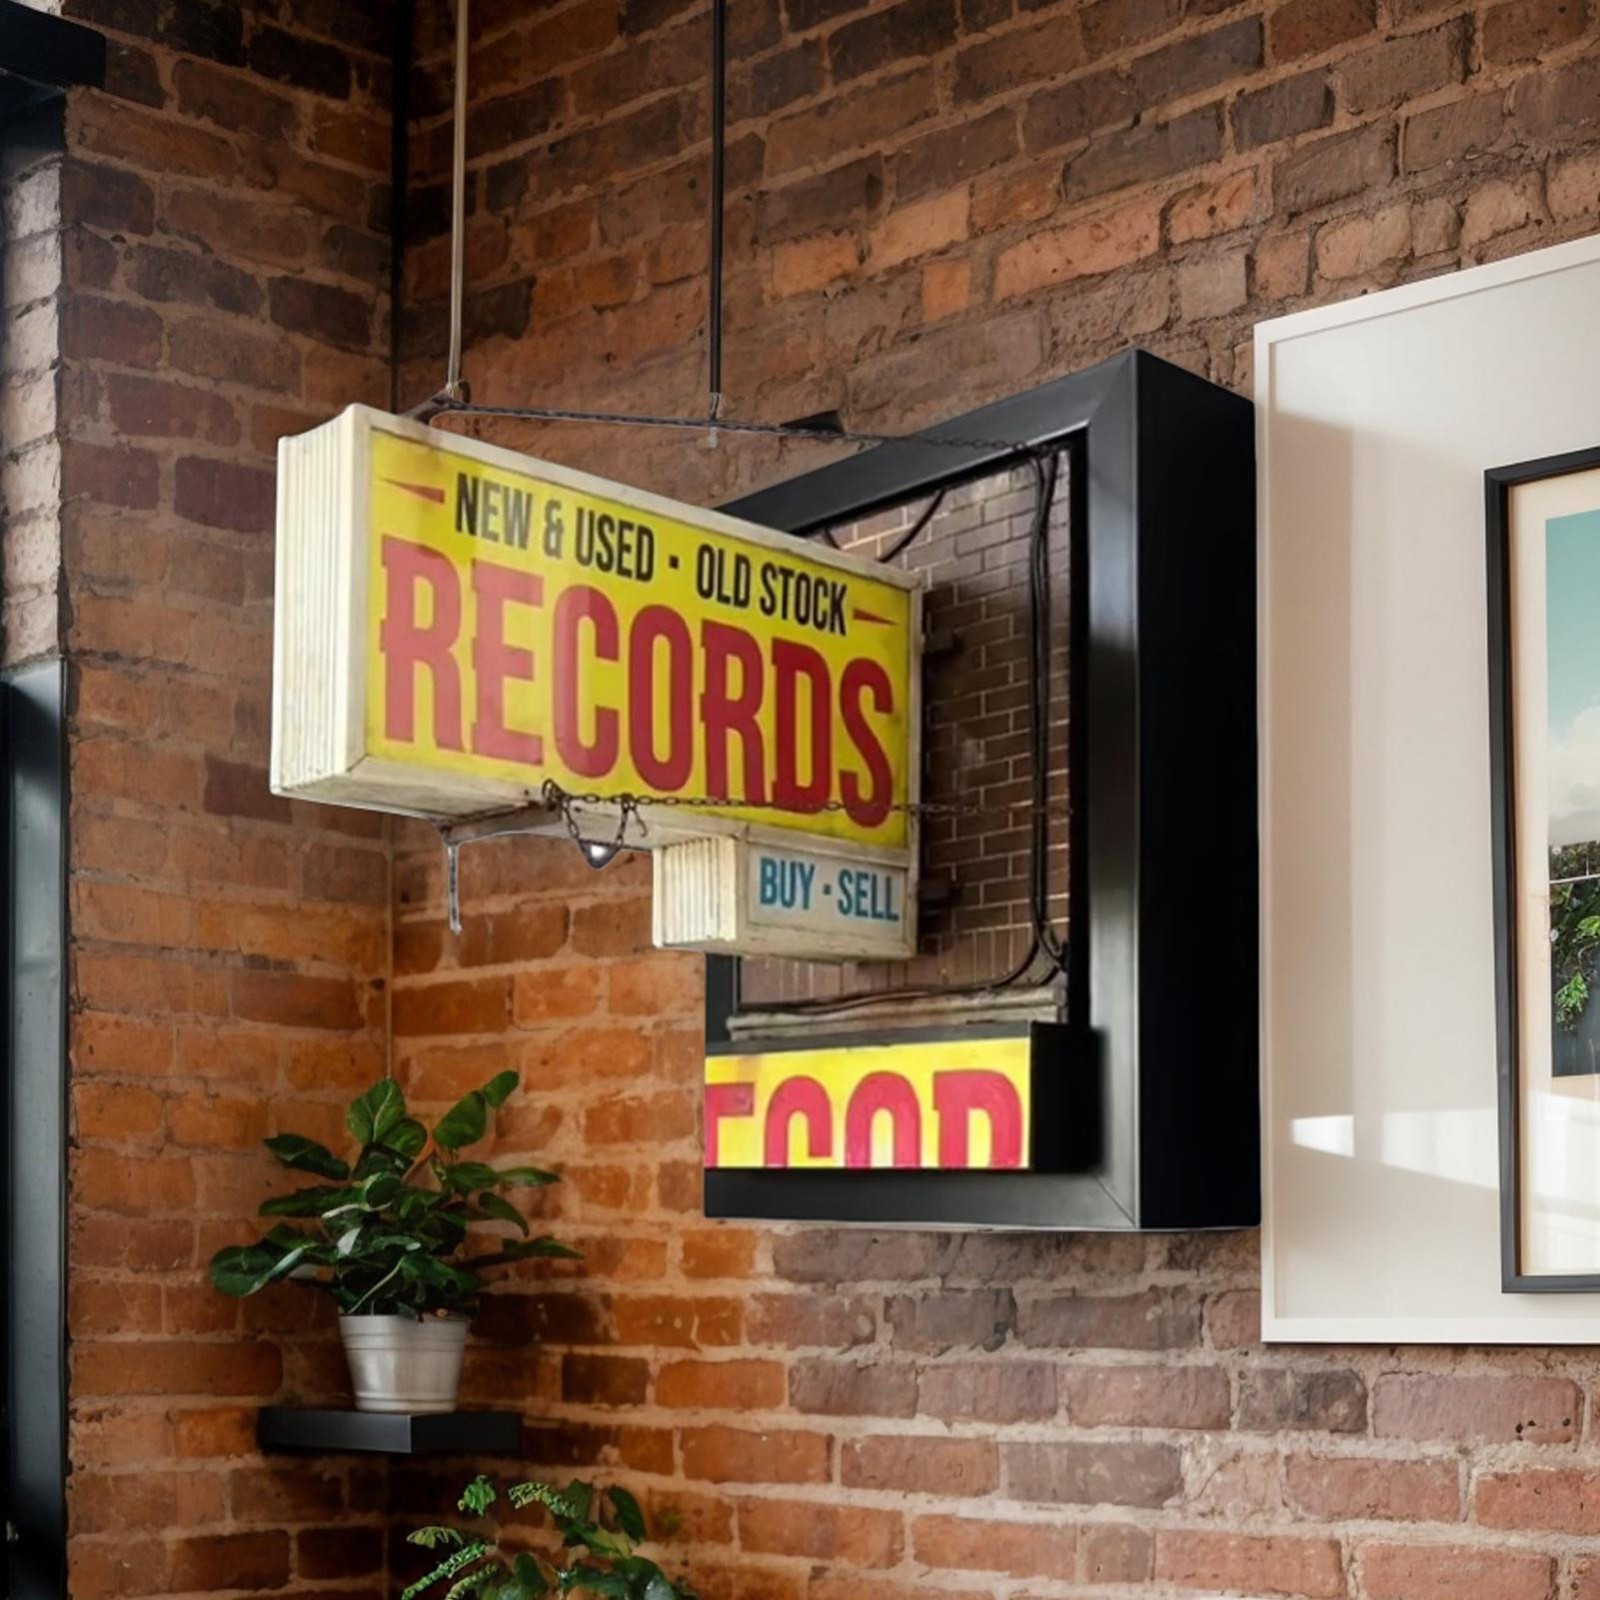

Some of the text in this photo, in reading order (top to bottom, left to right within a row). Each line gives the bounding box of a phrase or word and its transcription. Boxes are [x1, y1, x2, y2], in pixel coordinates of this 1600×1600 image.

[455, 472, 848, 636] NEW & USED OLD STOCK
[380, 533, 894, 828] RECORDS
[760, 857, 899, 922] BUY SELL
